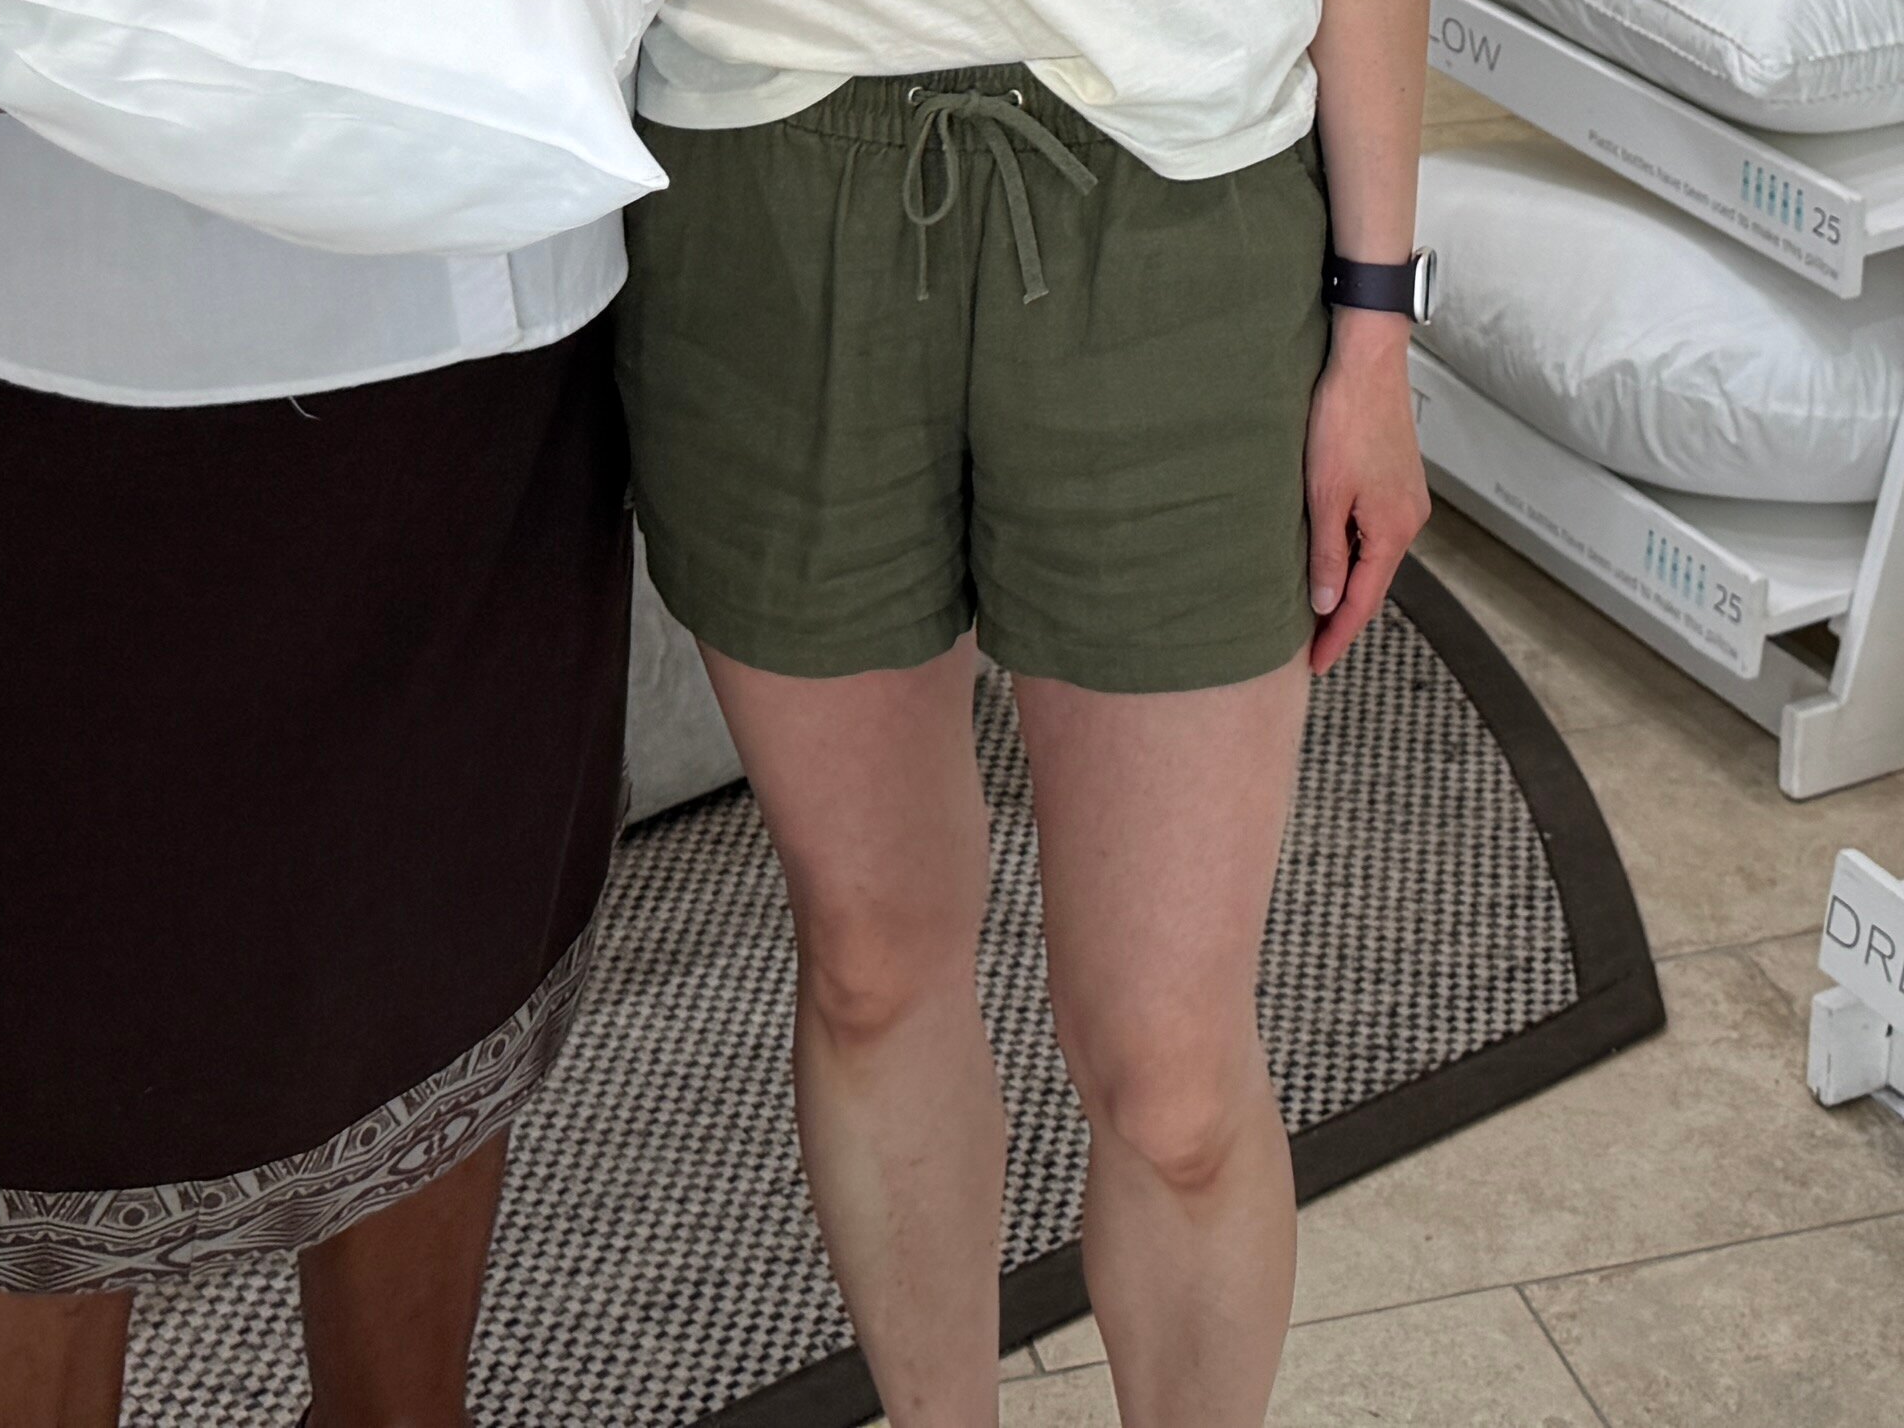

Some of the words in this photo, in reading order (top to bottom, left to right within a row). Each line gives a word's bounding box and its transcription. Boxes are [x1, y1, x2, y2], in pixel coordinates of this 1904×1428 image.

[1429, 17, 1502, 72] OW
[1810, 205, 1842, 246] 25
[1711, 582, 1743, 625] 25
